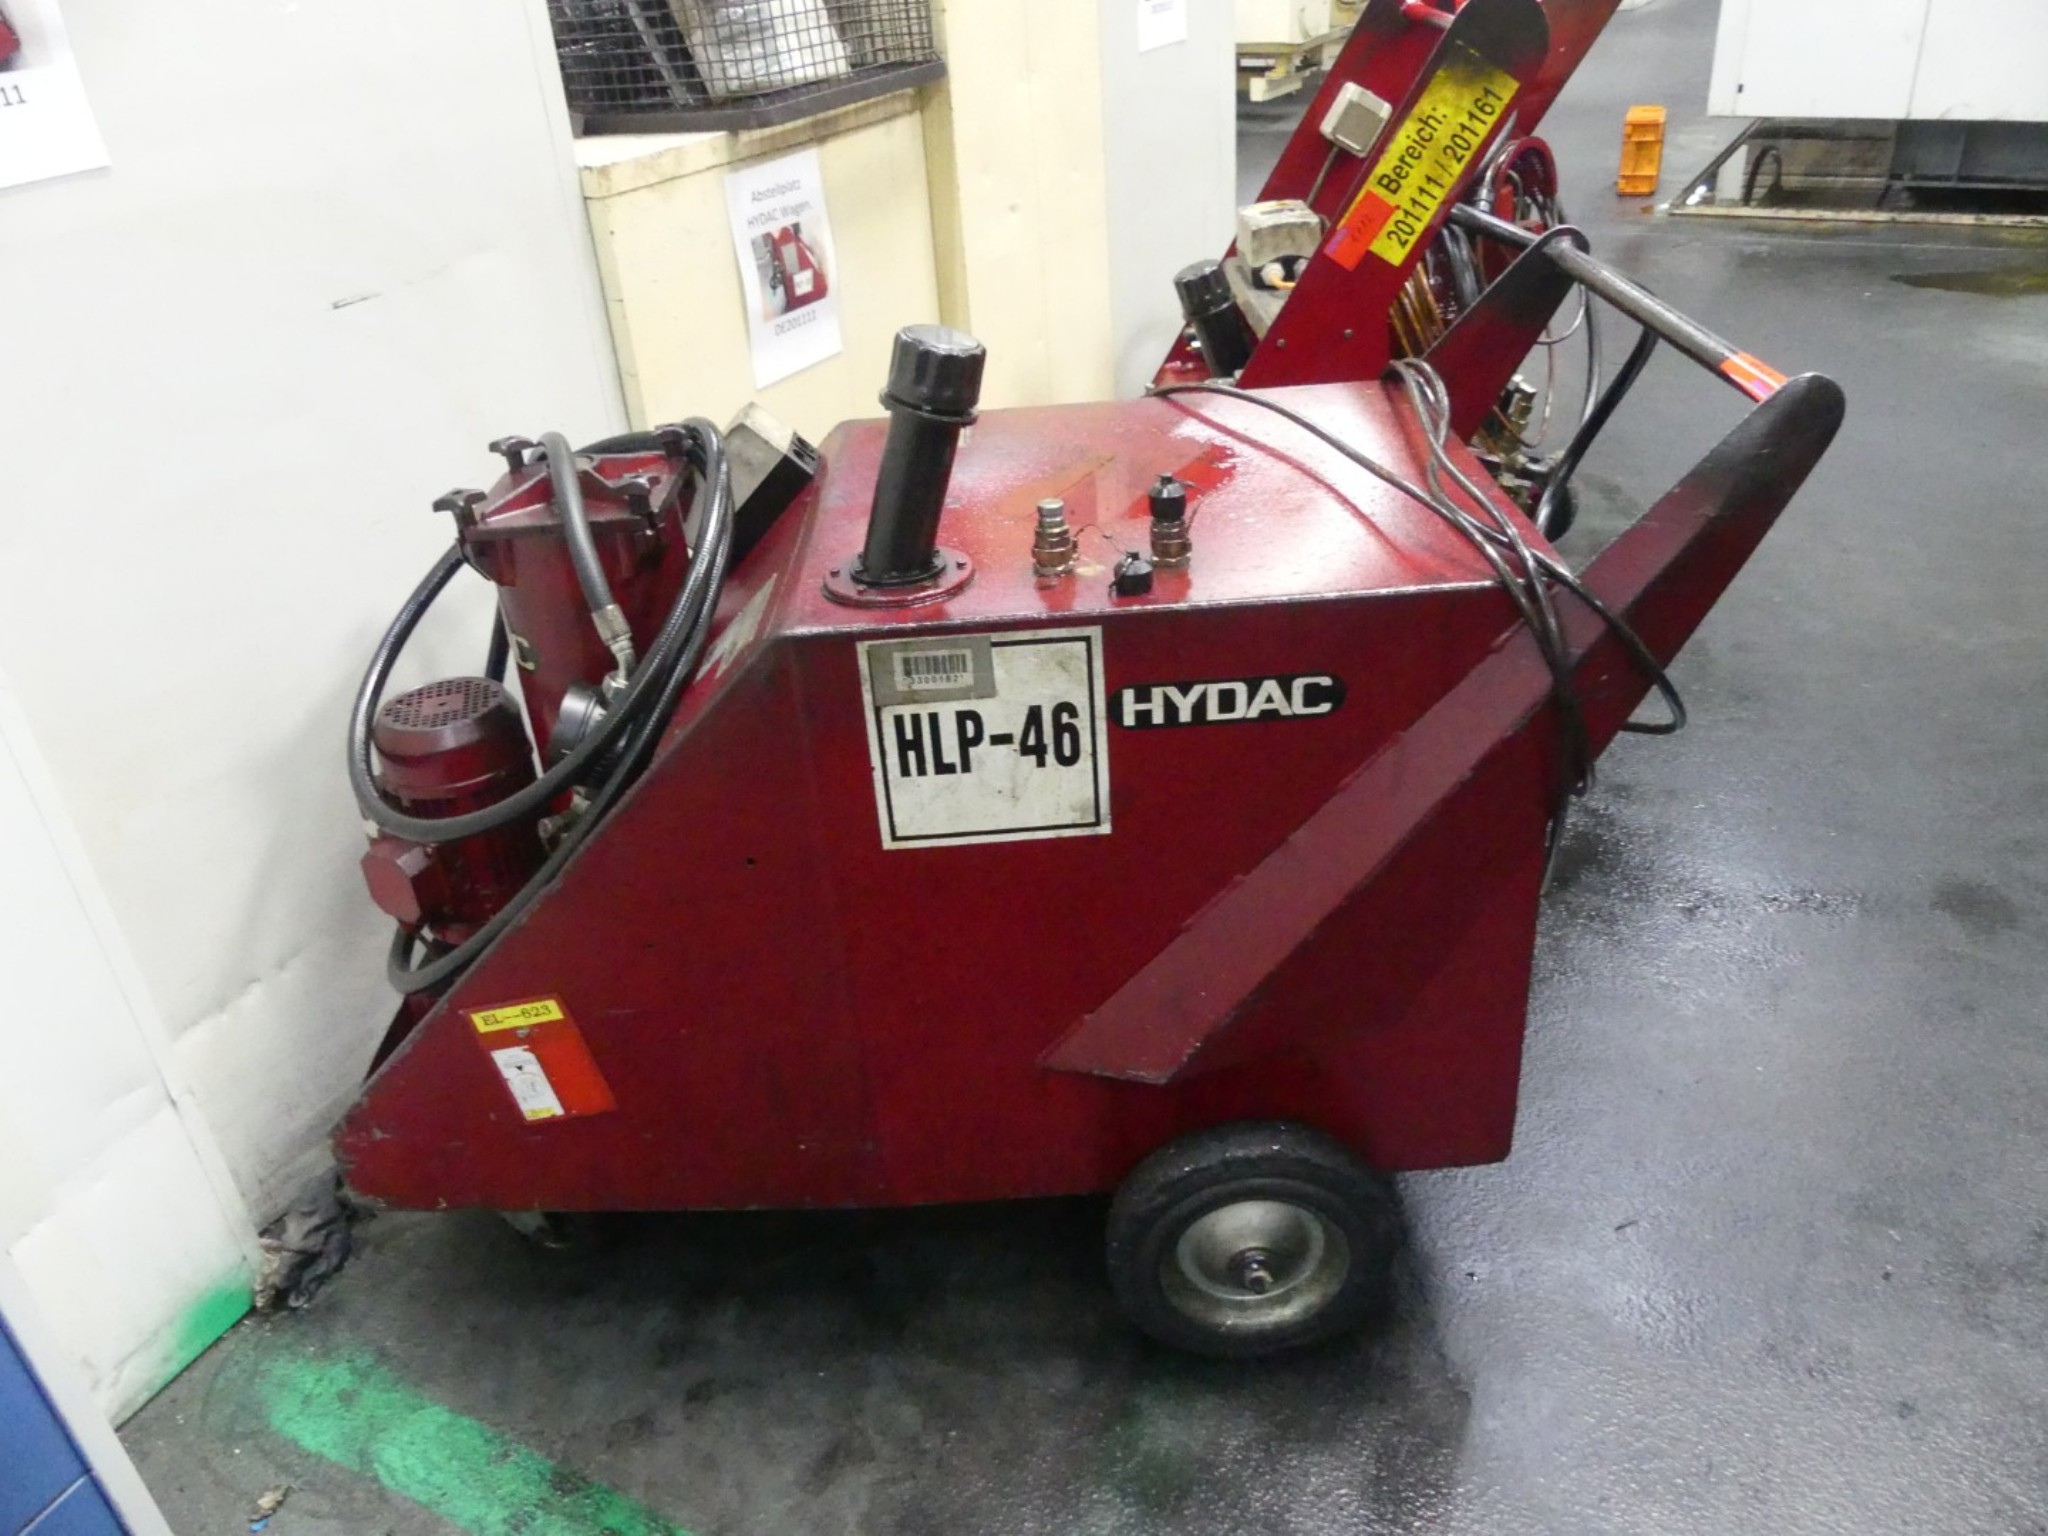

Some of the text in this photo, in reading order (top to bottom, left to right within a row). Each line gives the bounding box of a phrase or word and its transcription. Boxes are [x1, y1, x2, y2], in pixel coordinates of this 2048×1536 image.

[1377, 107, 1447, 195] Bereich:
[1387, 86, 1504, 249] 201111 / 201161
[747, 208, 779, 228] HYDAC
[893, 701, 1082, 777] HLP-46
[1122, 676, 1334, 727] HYDAC
